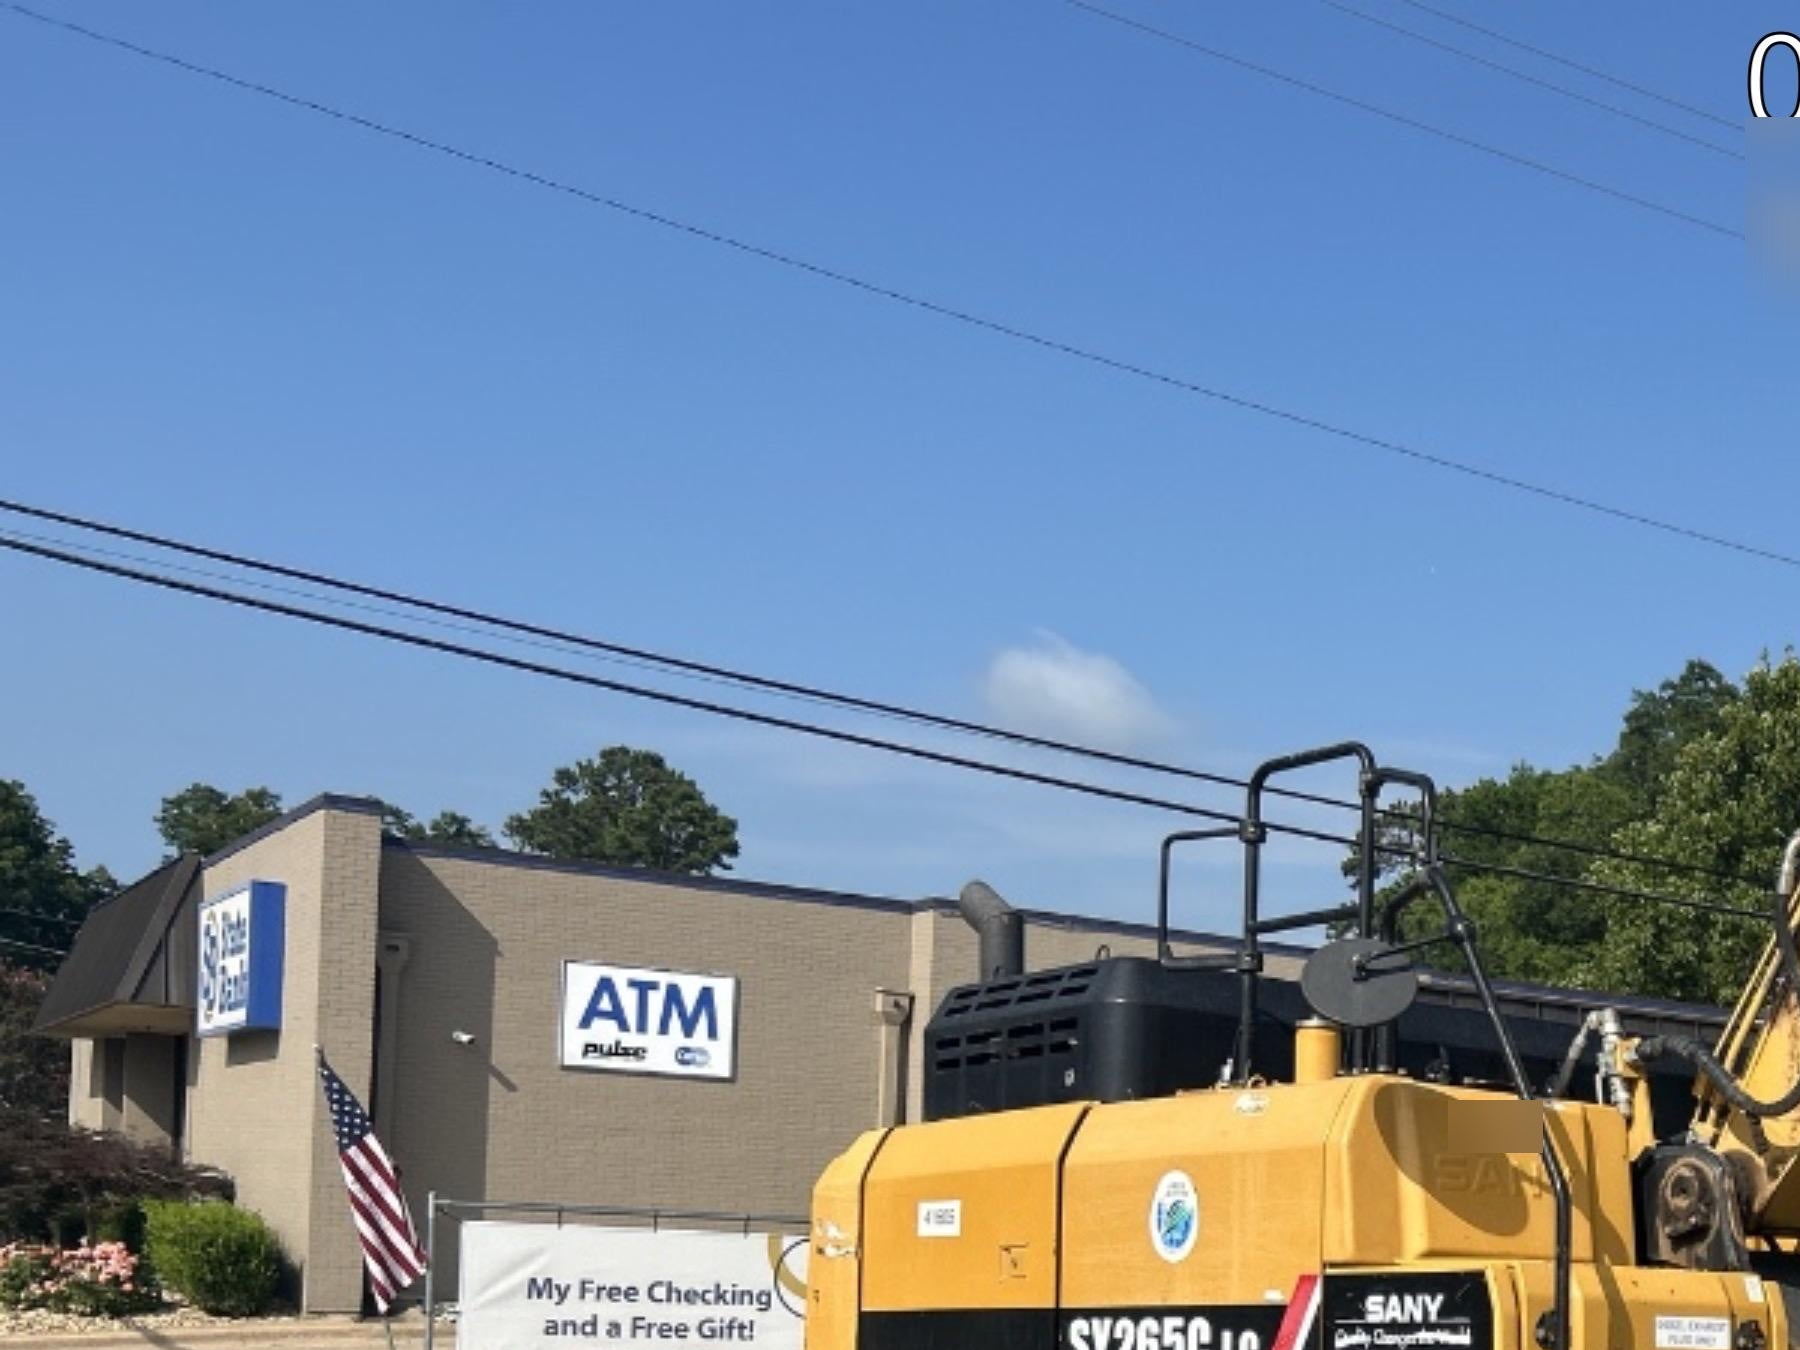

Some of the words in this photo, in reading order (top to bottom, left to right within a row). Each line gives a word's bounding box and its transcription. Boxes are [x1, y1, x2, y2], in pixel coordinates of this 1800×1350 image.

[577, 974, 719, 1042] ATM
[526, 1277, 571, 1305] My
[578, 1279, 640, 1304] Free
[647, 1280, 773, 1311] Checking
[1363, 1292, 1445, 1325] SANY
[543, 1314, 598, 1338] and
[605, 1321, 622, 1338] a
[630, 1316, 690, 1340] Free
[696, 1316, 755, 1342] Gift!
